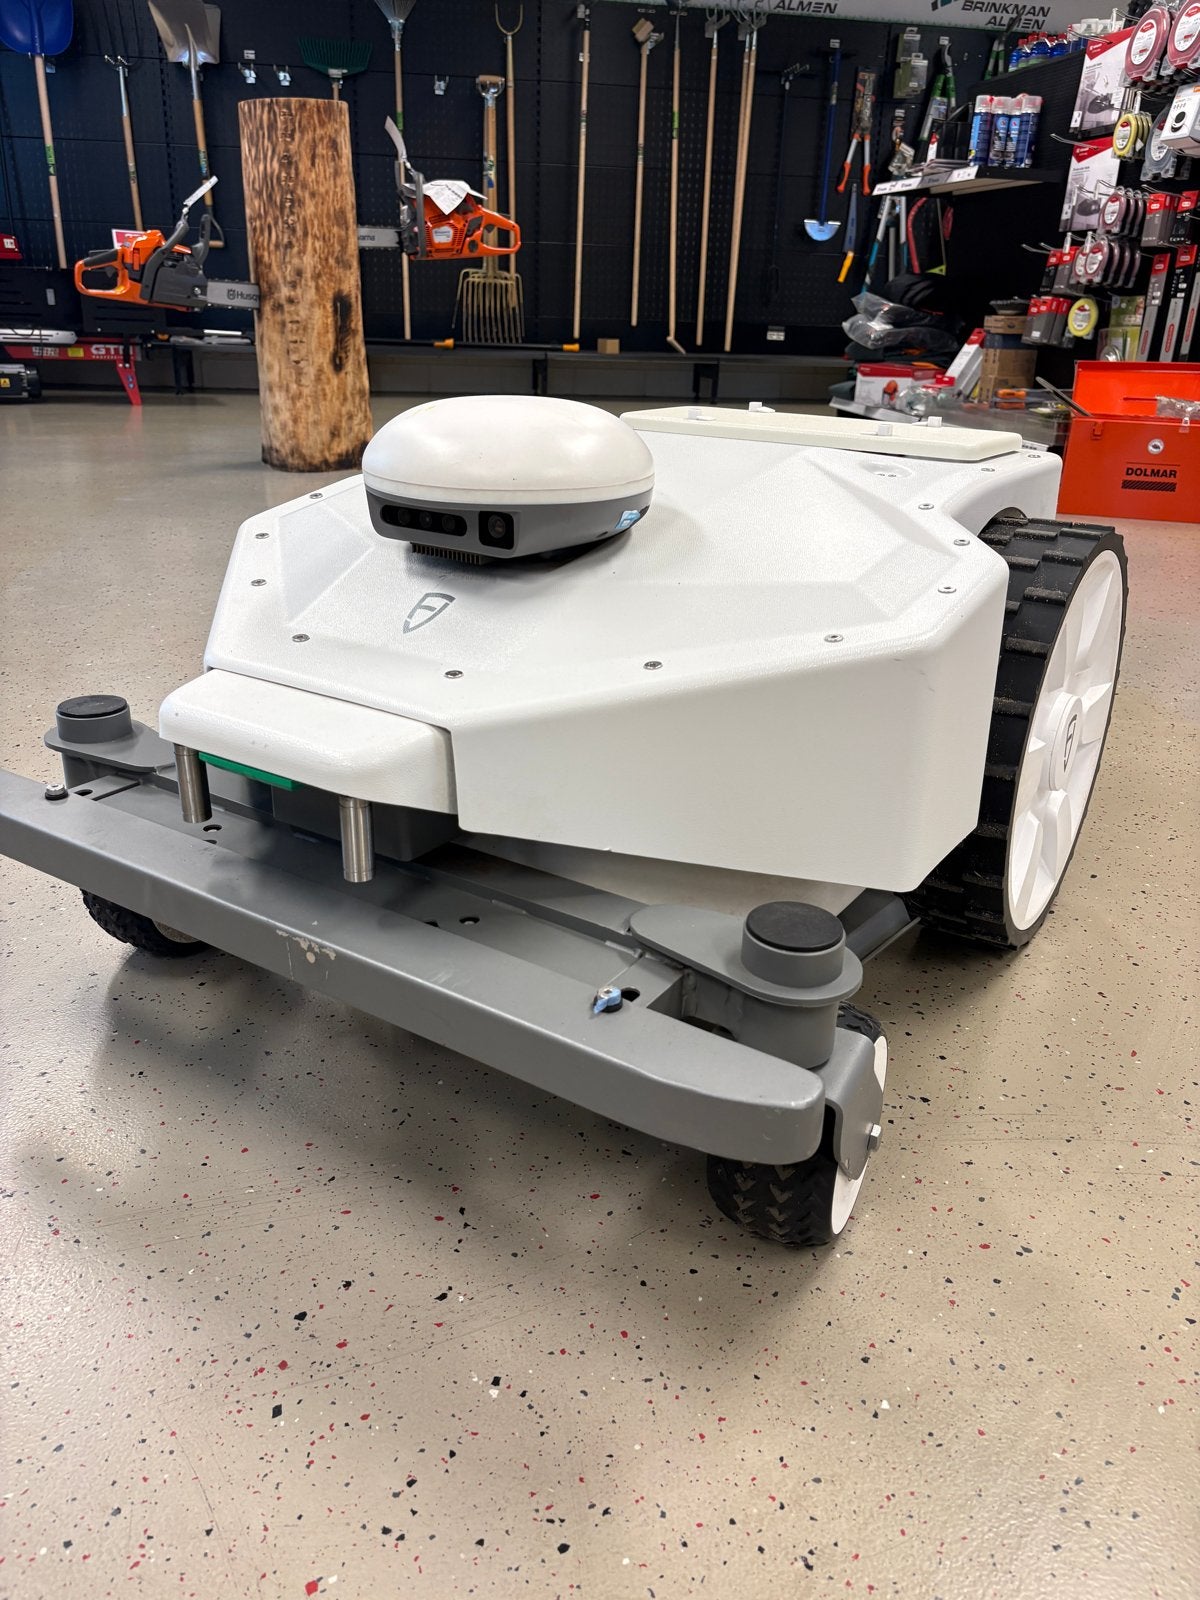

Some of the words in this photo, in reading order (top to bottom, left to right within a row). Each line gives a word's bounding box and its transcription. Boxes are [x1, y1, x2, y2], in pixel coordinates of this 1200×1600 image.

[773, 0, 838, 14] ALMEN
[961, 0, 1051, 17] BRINKMAN
[1125, 467, 1178, 478] DOLMAR
